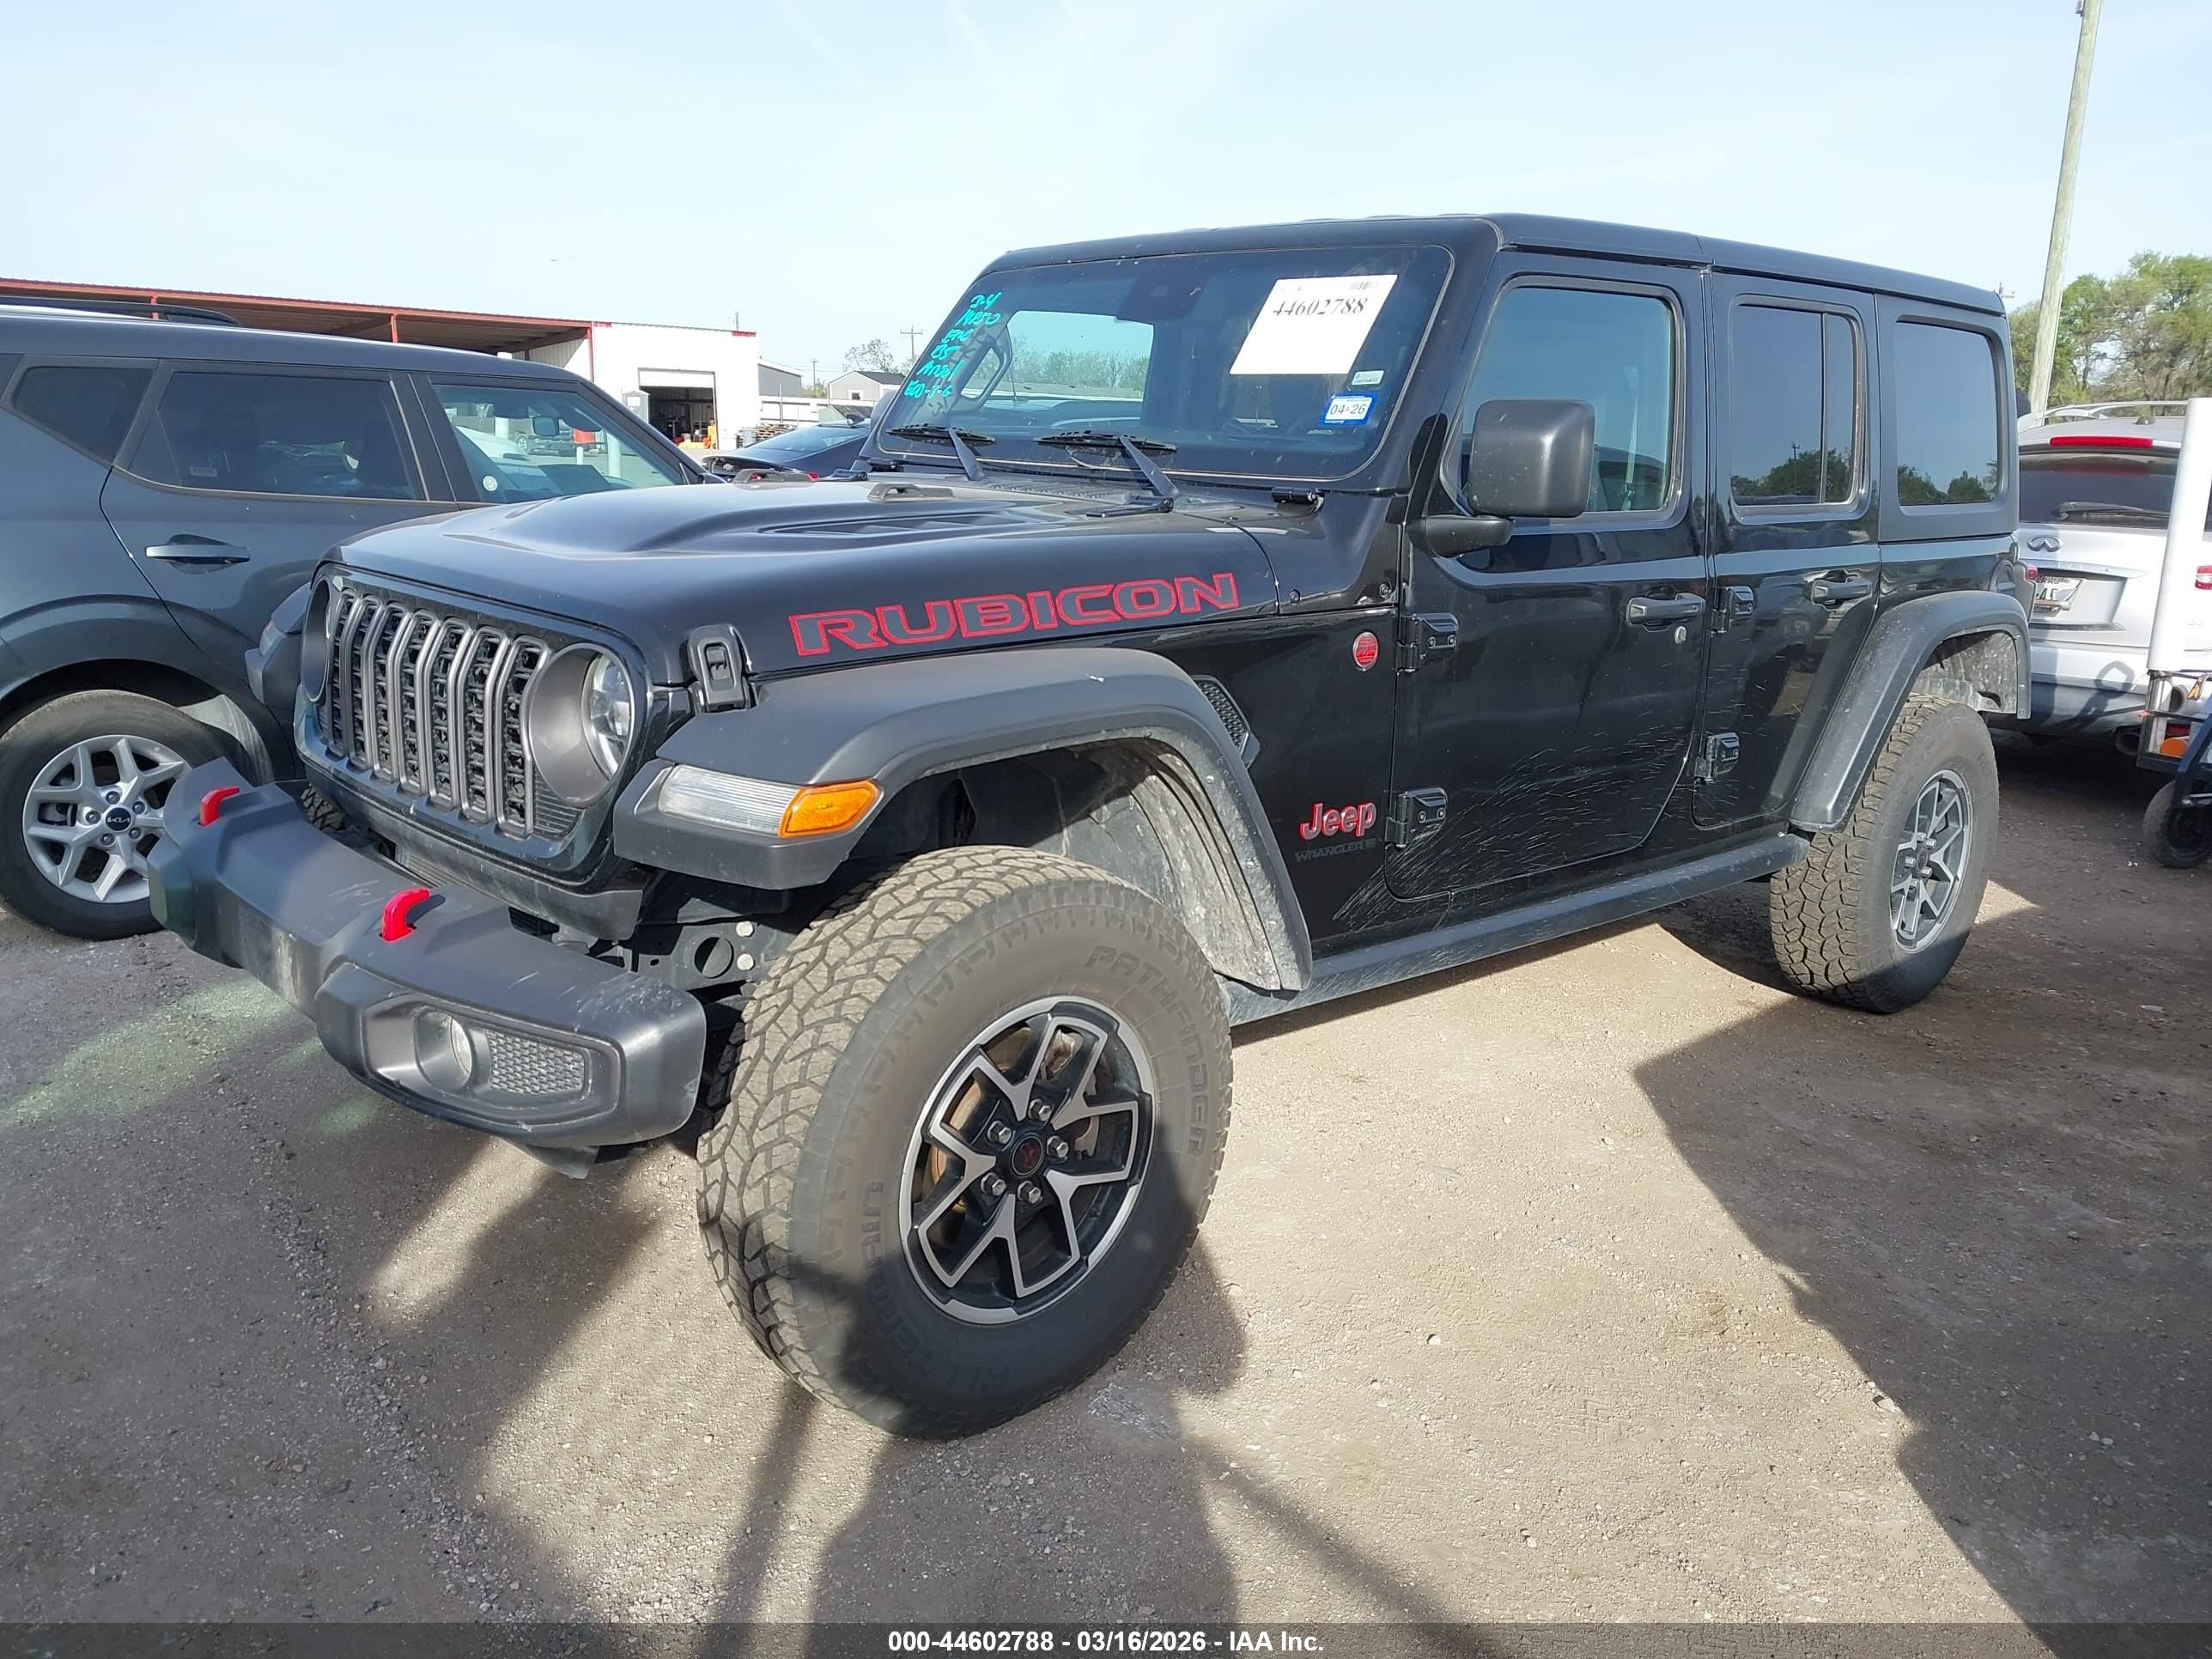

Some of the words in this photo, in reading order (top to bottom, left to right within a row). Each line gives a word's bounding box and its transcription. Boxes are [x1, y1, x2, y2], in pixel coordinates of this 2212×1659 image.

[1273, 298, 1368, 316] 44602788
[788, 572, 1240, 657] RUBICON
[1299, 802, 1377, 840] Jeep
[1085, 945, 1209, 1157] PATHFINDER
